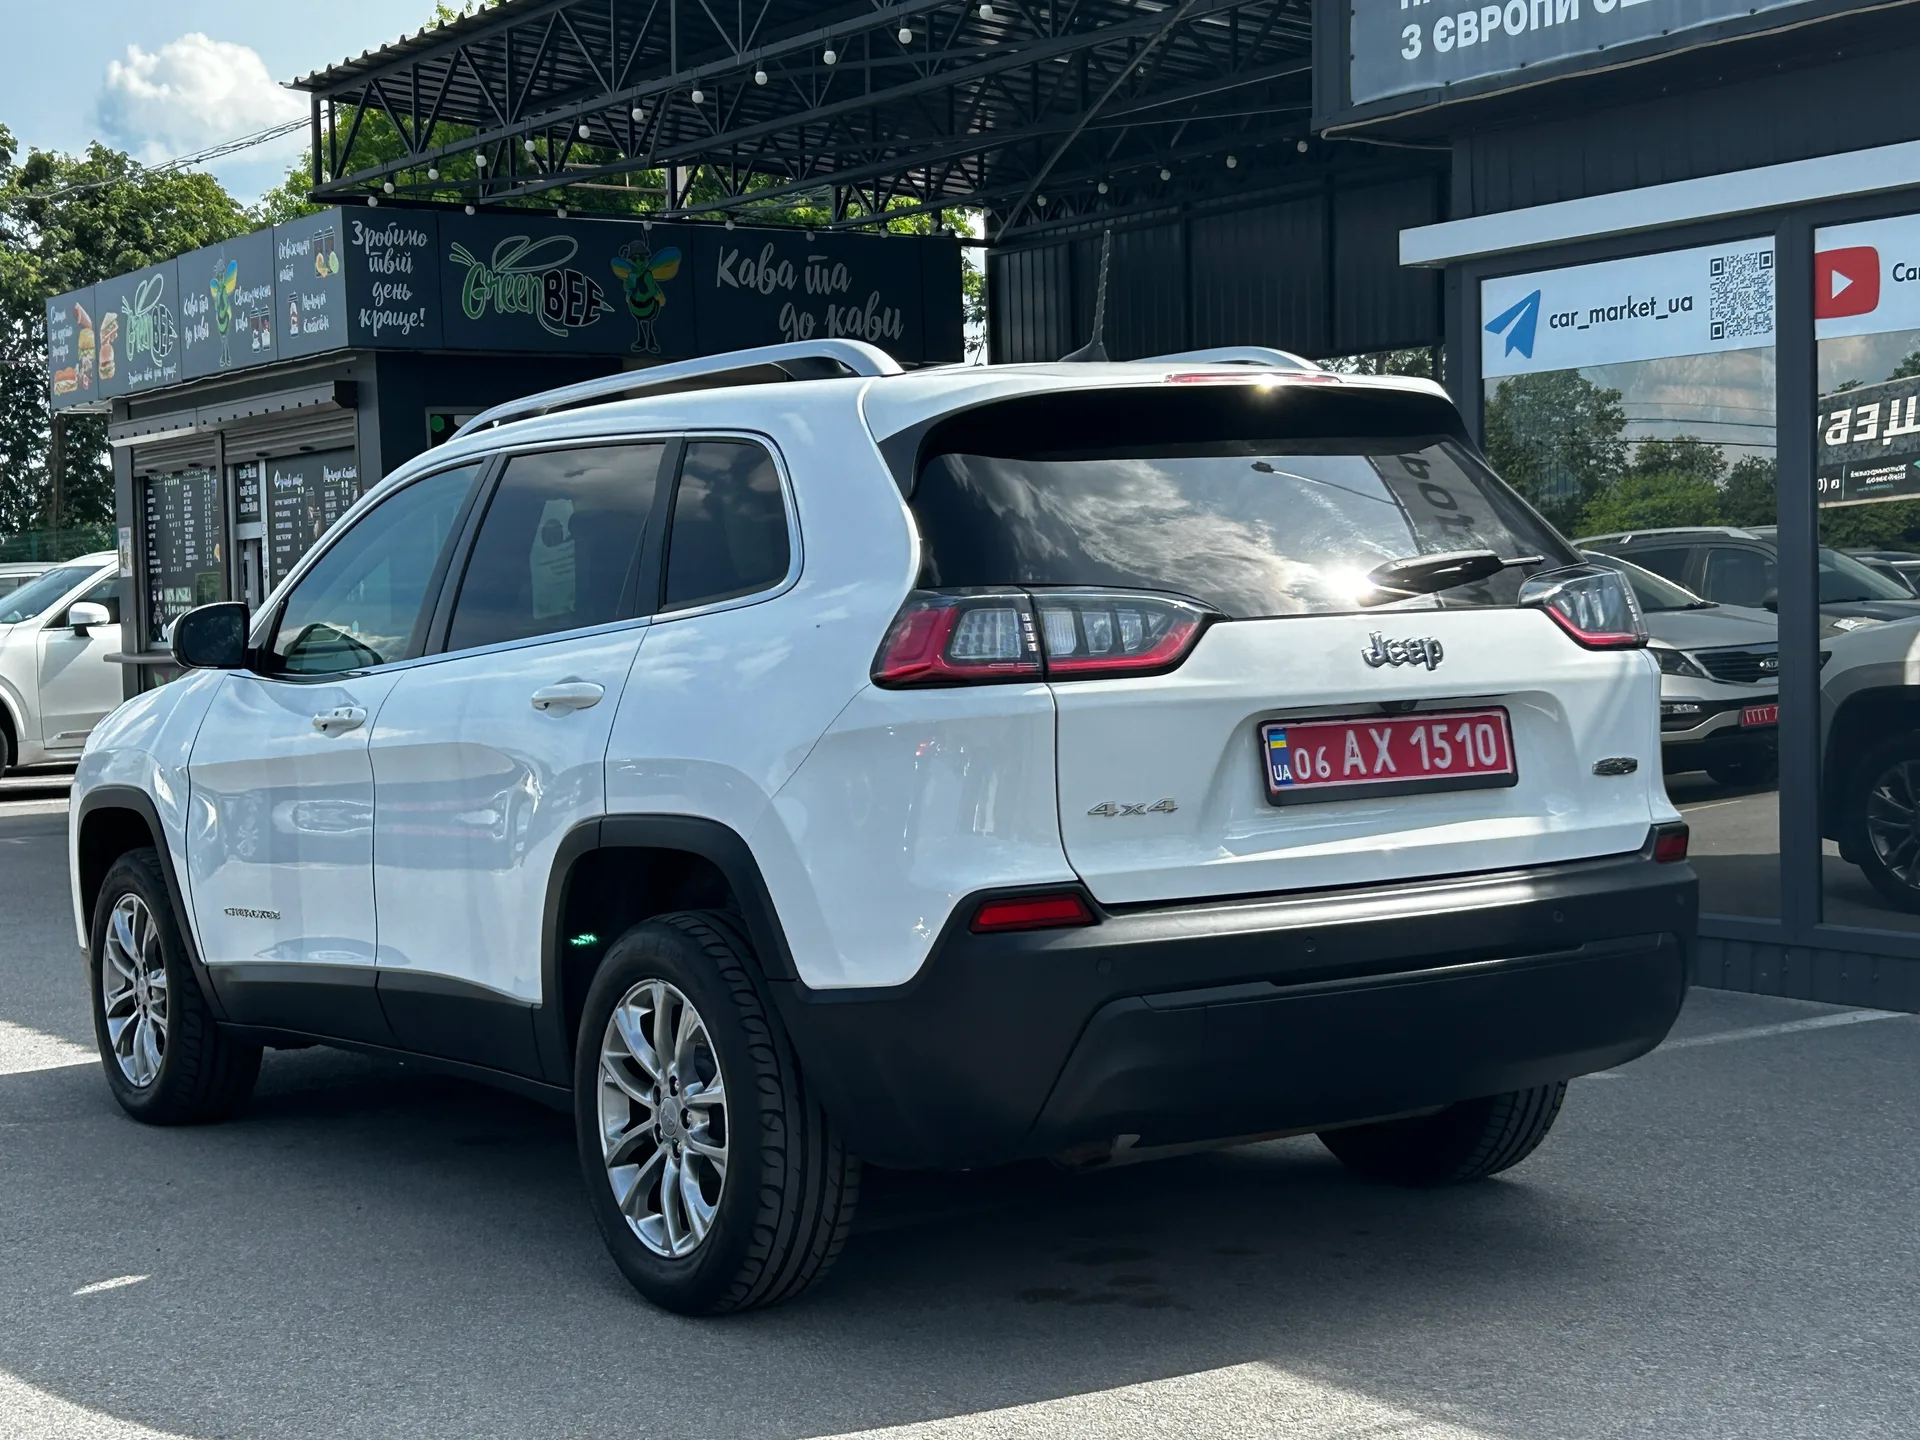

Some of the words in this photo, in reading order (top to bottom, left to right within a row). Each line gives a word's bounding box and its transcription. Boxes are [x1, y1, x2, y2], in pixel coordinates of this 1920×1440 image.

[1401, 24, 1422, 60] З
[1433, 0, 1579, 52] ЄВРОПИ
[352, 220, 428, 255] Зробимо
[369, 248, 413, 274] твій
[716, 242, 798, 295] Кава
[804, 255, 852, 295] та
[1892, 262, 1920, 283] Ca
[372, 282, 413, 307] день
[358, 308, 426, 337] краще!
[779, 302, 816, 342] до
[824, 290, 904, 341] кави
[1549, 295, 1693, 330] car_market_ua
[1361, 631, 1444, 672] Jeep
[1294, 746, 1331, 780] 06
[1343, 727, 1396, 776] AX
[1409, 722, 1497, 771] 1510
[1273, 764, 1293, 781] UA
[1087, 797, 1179, 817] 4x4
